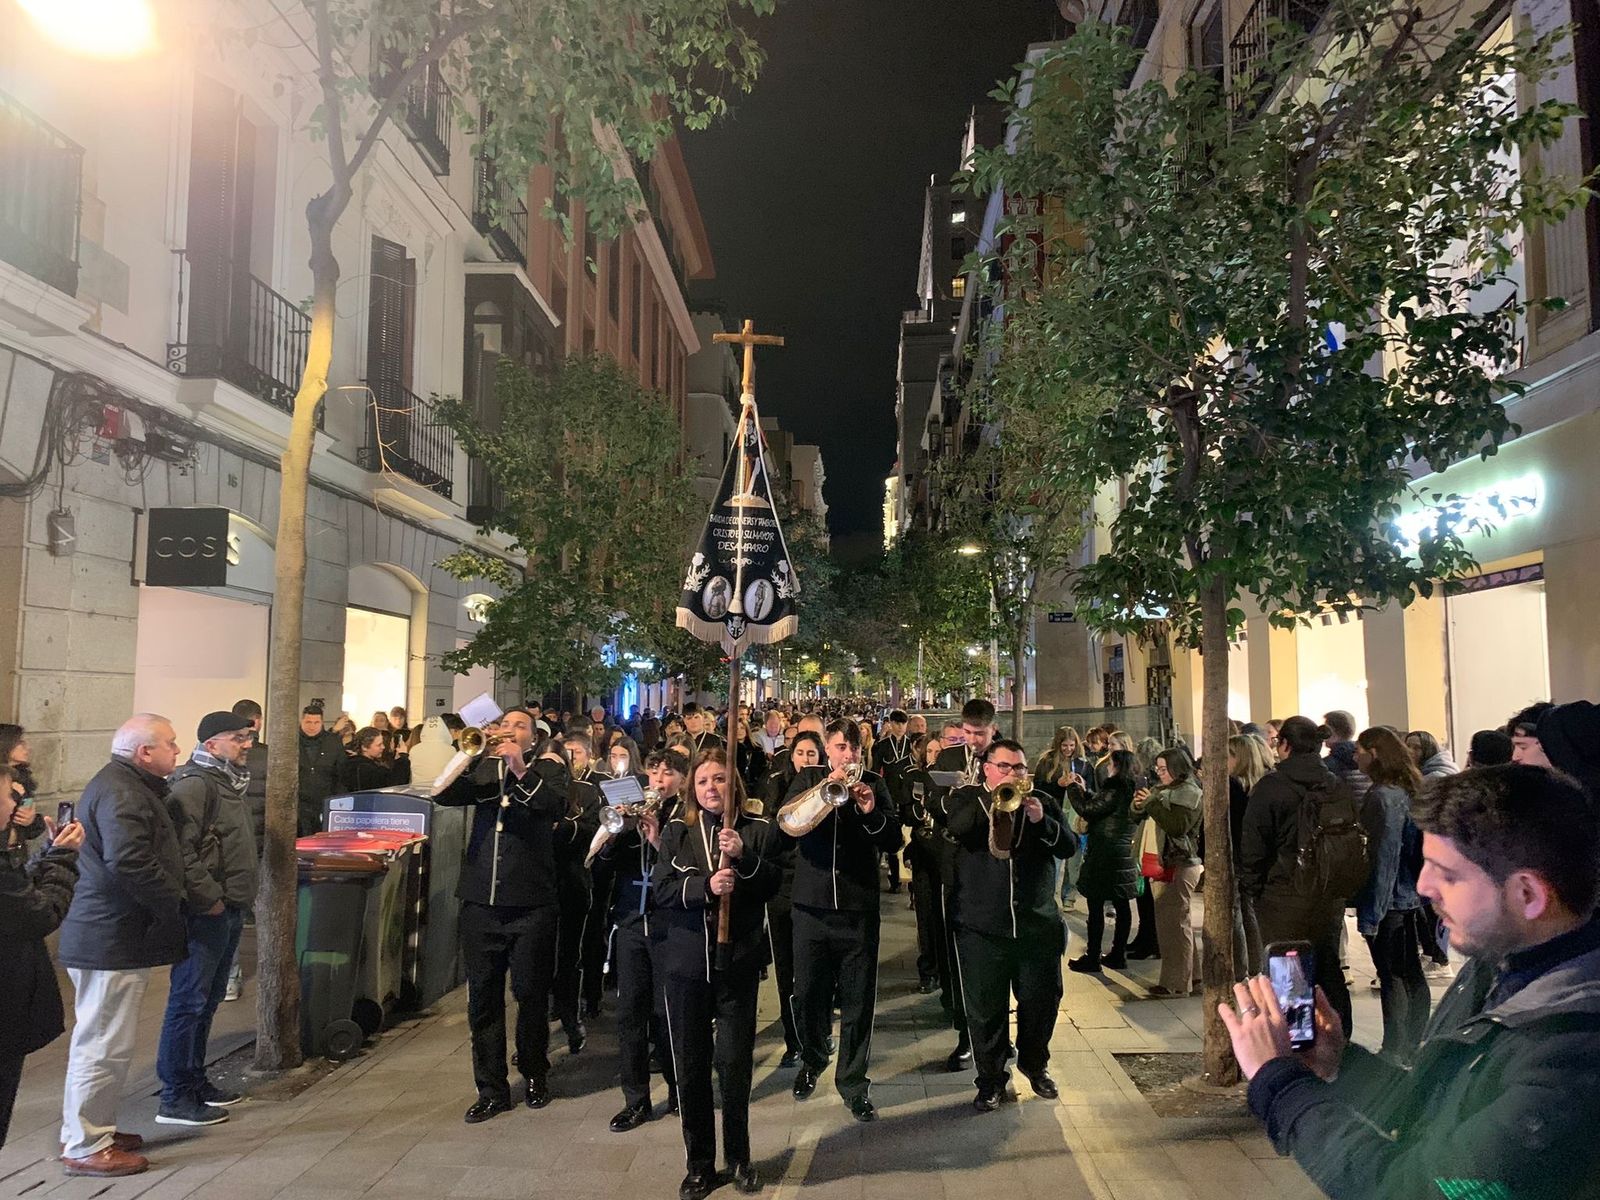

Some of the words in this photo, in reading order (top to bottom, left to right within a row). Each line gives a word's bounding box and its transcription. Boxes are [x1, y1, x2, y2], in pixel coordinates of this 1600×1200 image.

[712, 527, 735, 538] CRISTO
[752, 530, 775, 541] MAYOR
[154, 536, 218, 558] COS
[334, 815, 354, 824] Cada
[356, 816, 389, 826] papelera
[390, 816, 409, 825] tiene
